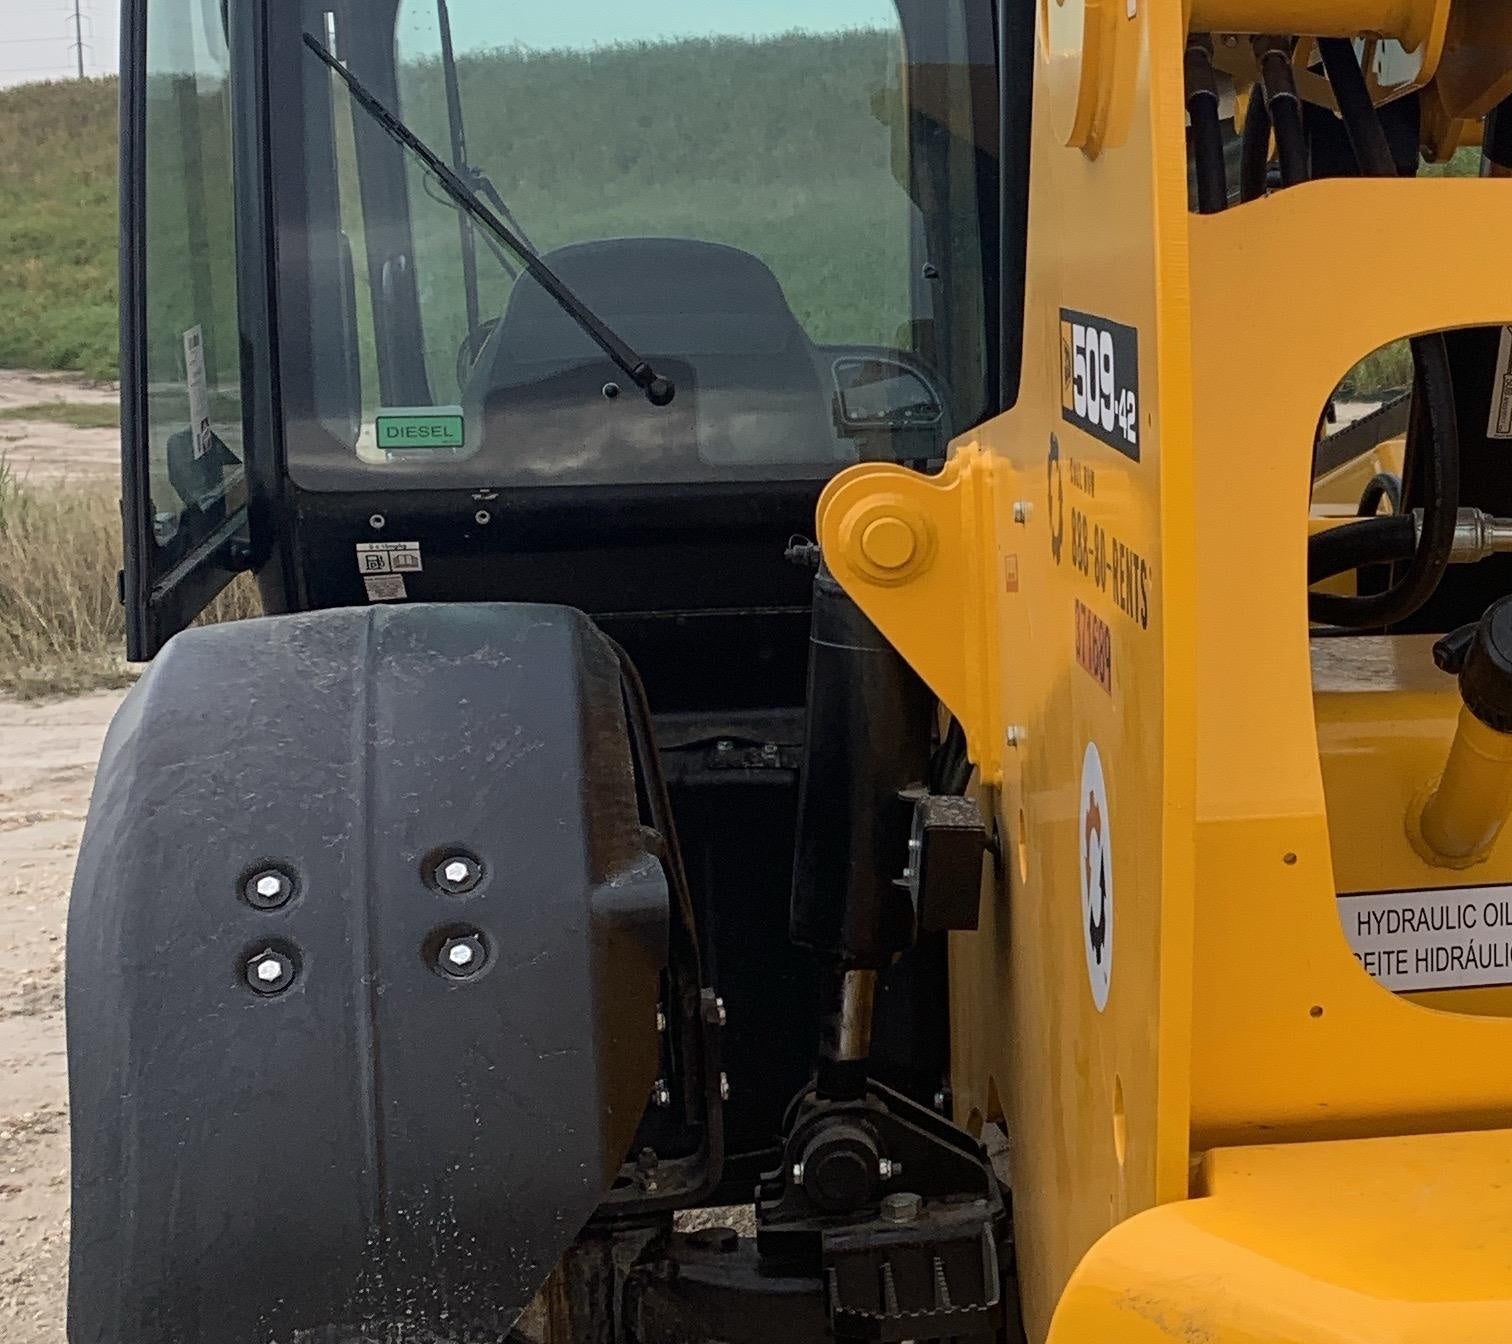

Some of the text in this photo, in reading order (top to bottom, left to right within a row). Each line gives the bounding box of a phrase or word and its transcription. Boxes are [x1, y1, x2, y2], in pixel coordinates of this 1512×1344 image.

[386, 425, 453, 439] DIESEL
[1074, 598, 1112, 692] 371689
[1357, 903, 1476, 936] HYDRAULIC
[1352, 950, 1408, 976] EITE
